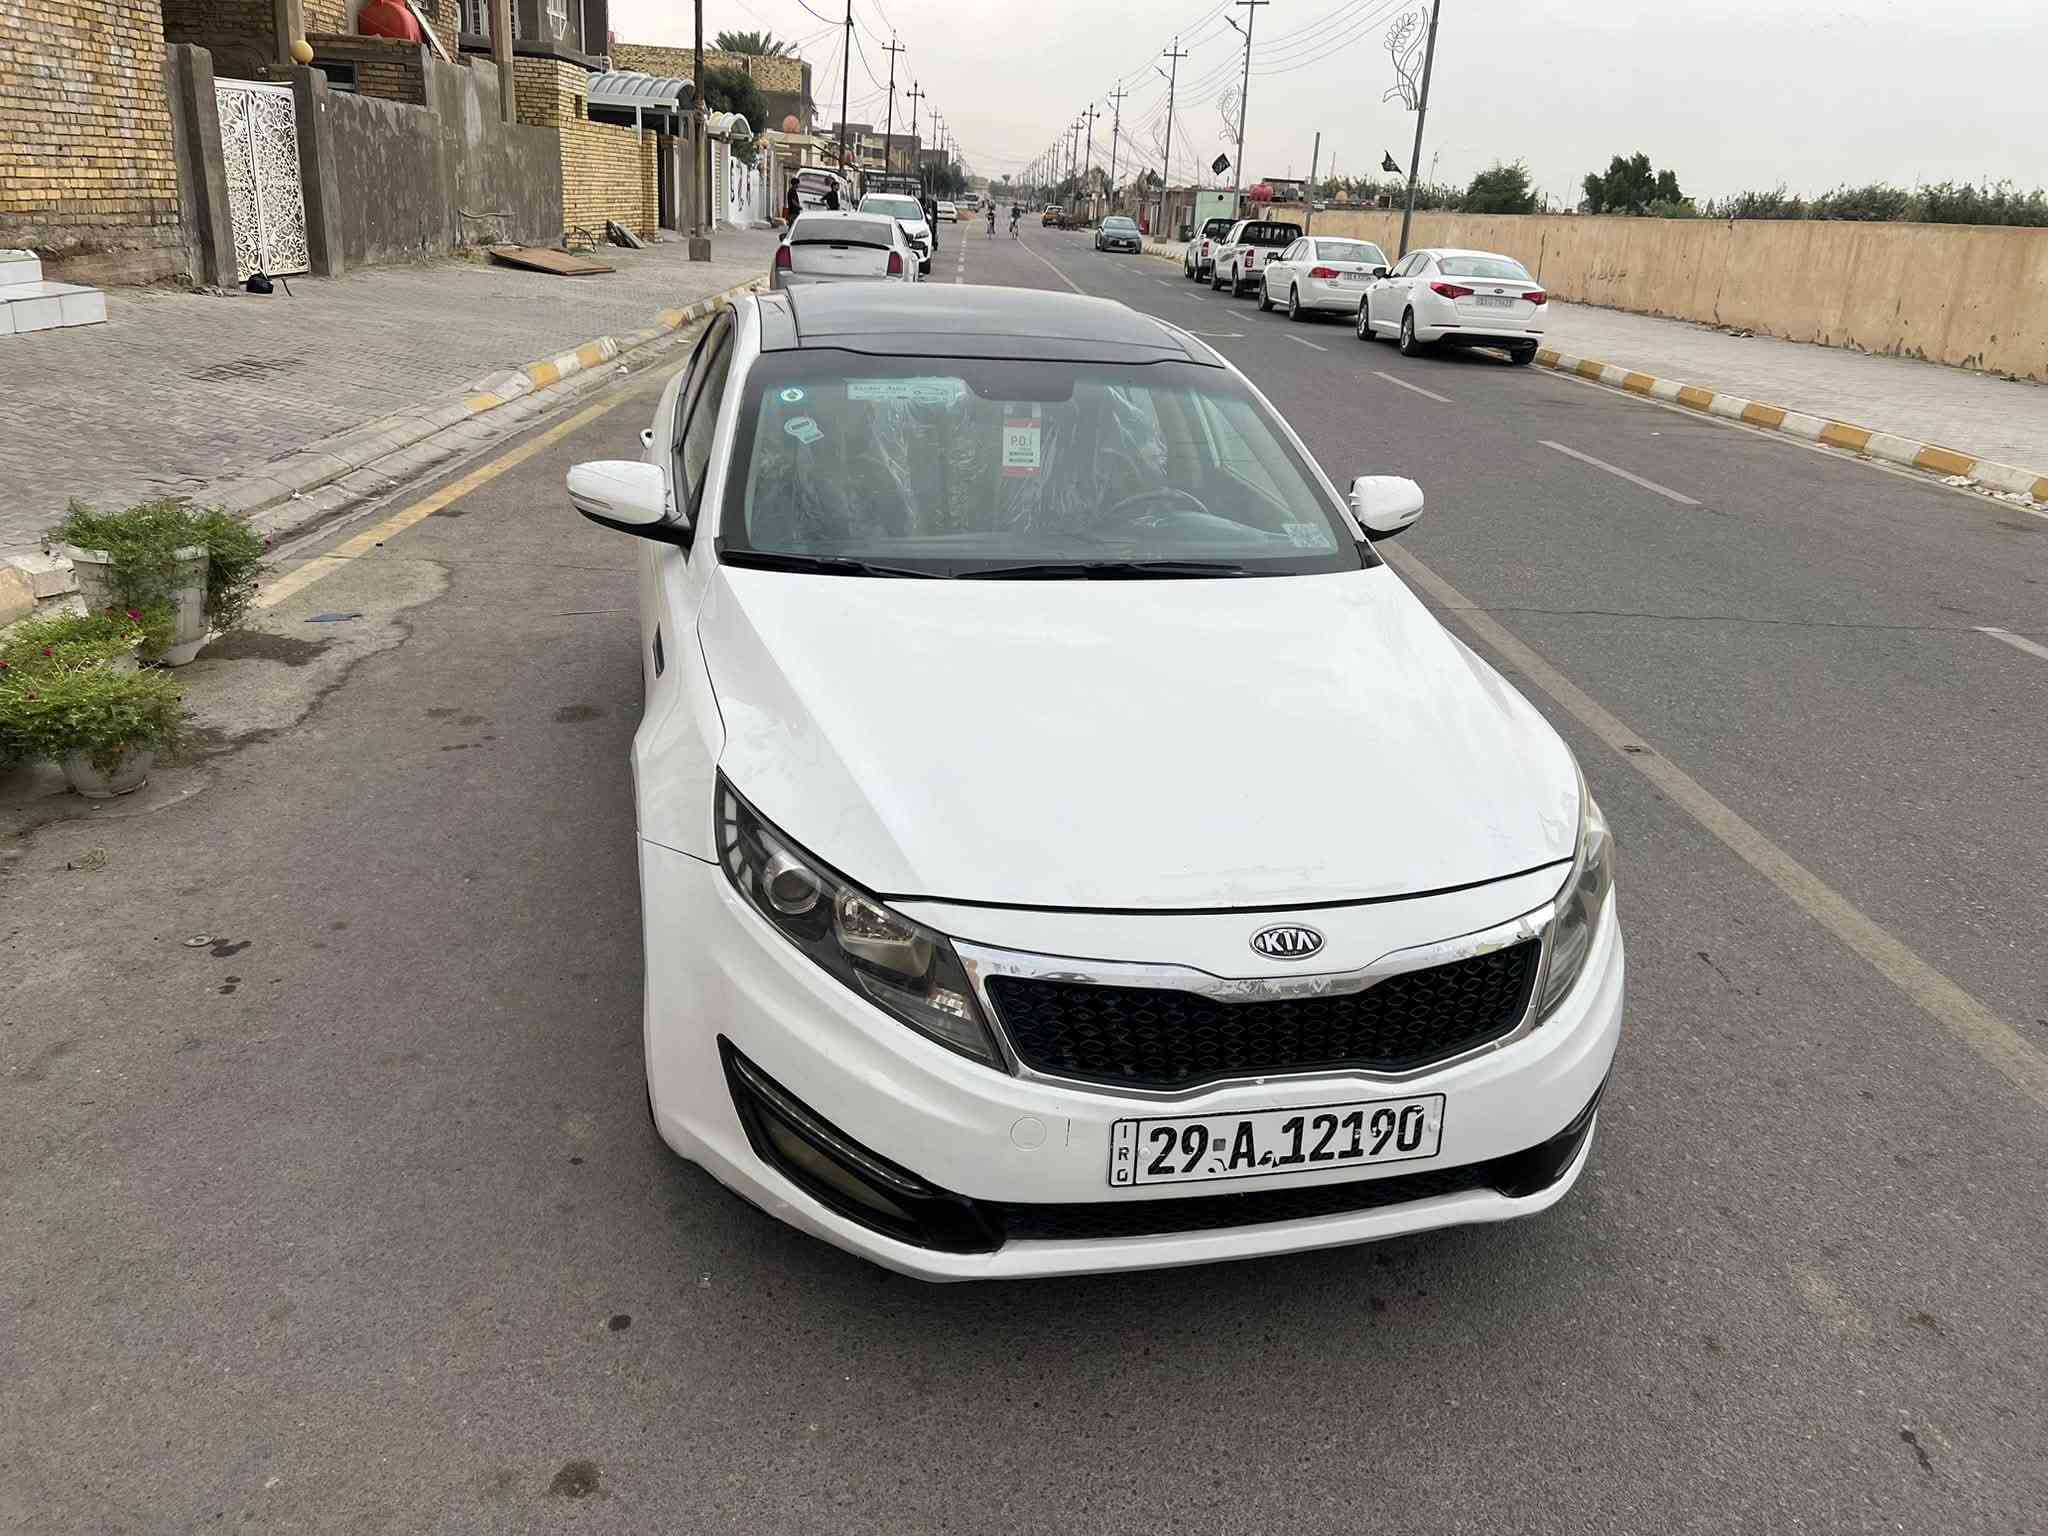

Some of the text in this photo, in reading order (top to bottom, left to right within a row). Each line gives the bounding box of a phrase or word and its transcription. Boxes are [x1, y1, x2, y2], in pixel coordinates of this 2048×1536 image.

[1263, 931, 1315, 952] KIA
[1147, 1104, 1425, 1175] 29 A 12190
